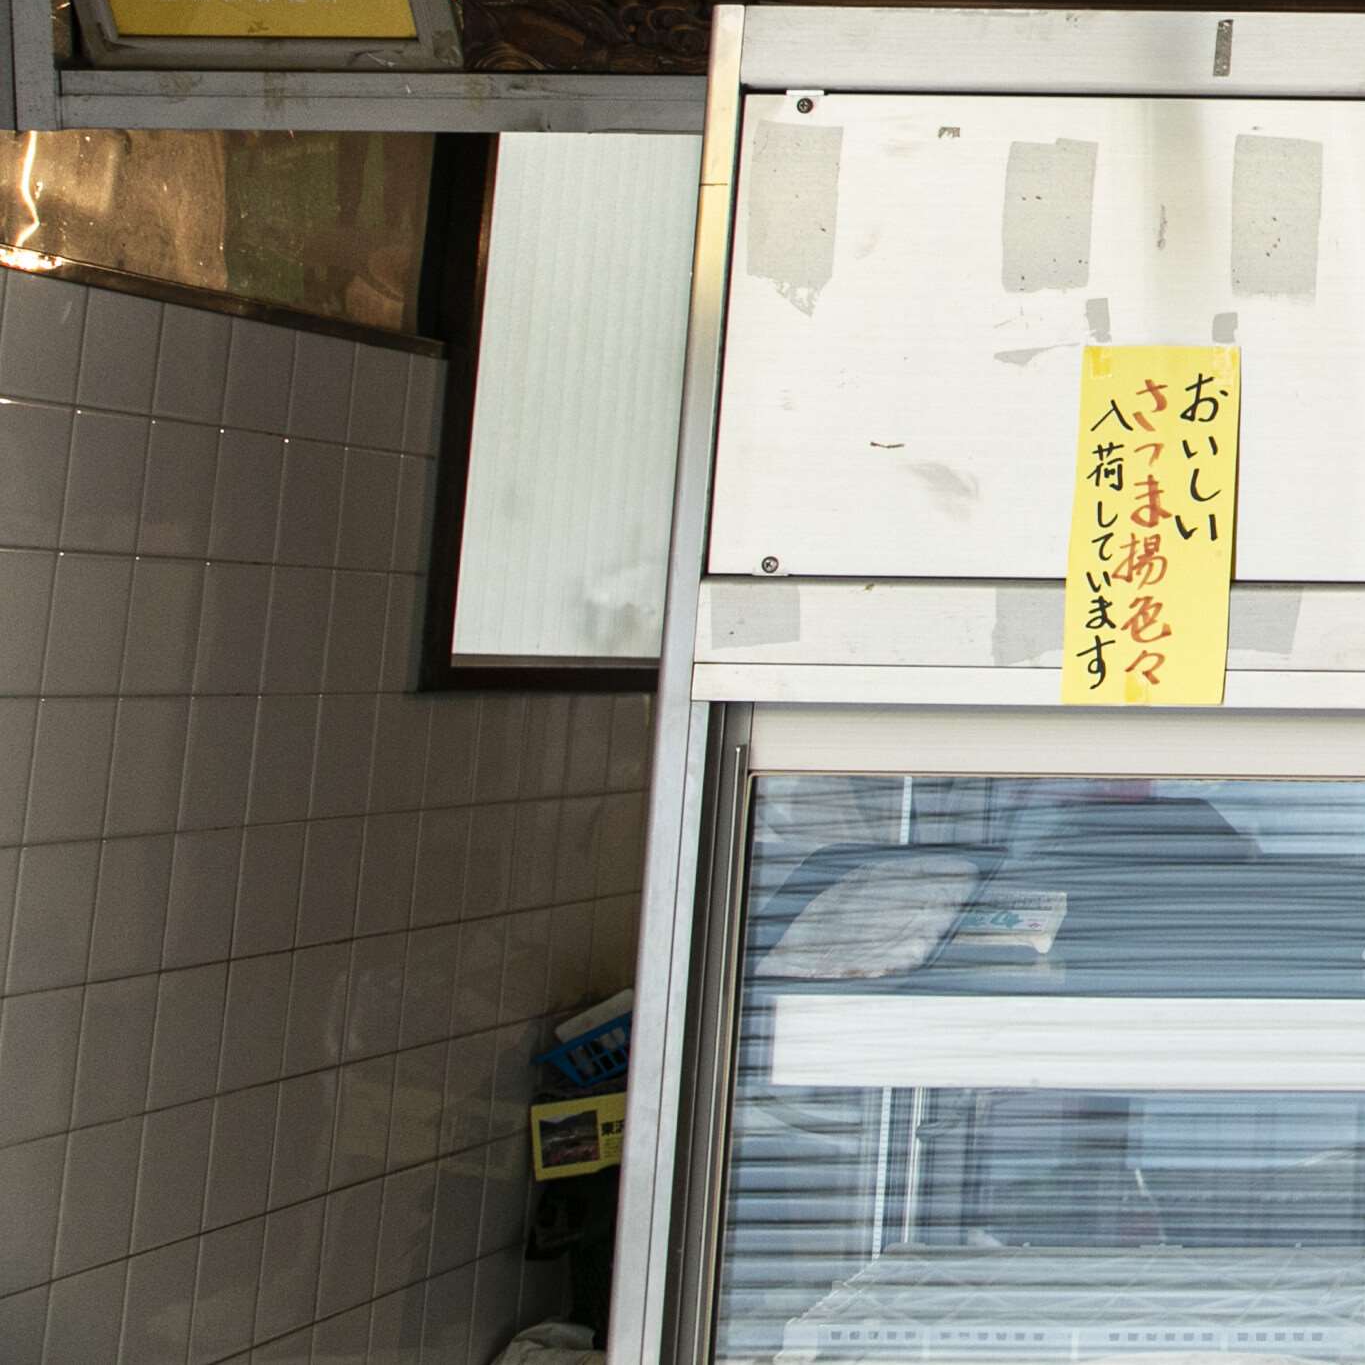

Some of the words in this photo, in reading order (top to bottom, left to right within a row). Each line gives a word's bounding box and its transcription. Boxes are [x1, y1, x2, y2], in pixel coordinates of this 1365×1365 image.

[1077, 399, 1134, 690] 入荷しています
[1111, 379, 1173, 685] さつま揚色々
[1175, 374, 1229, 542] おいしい
